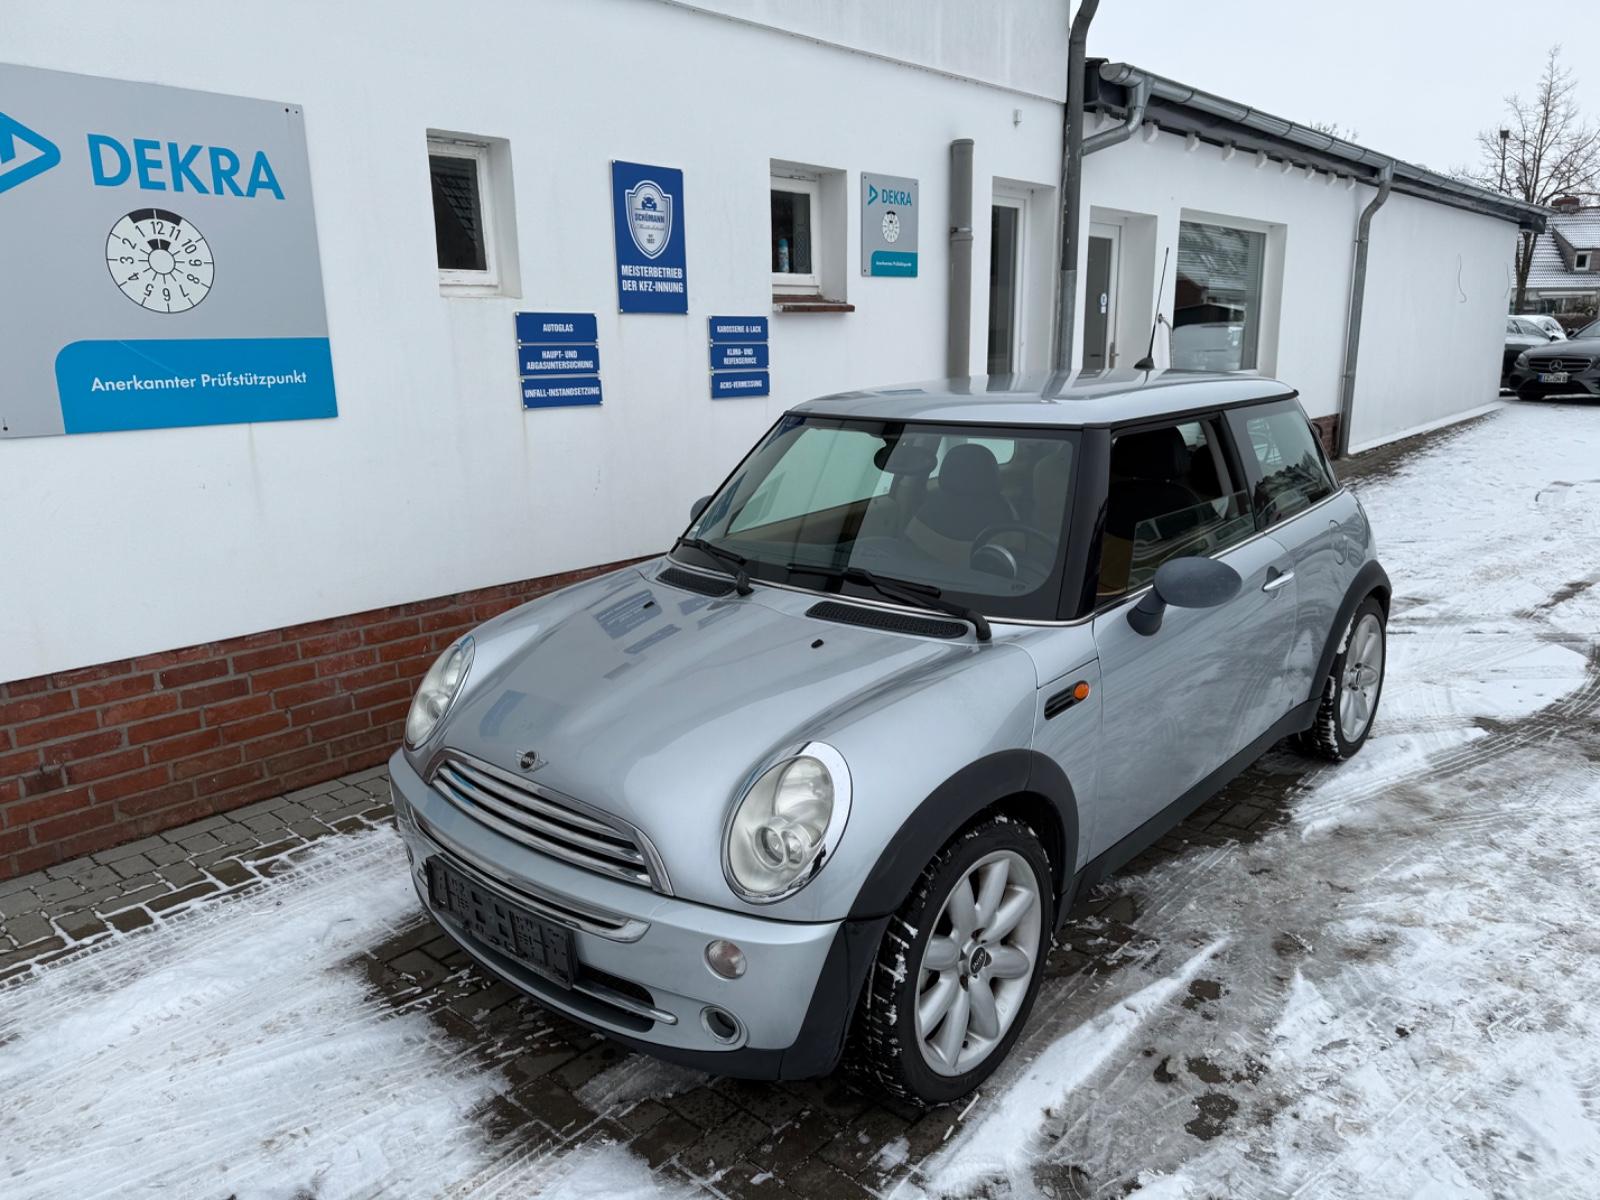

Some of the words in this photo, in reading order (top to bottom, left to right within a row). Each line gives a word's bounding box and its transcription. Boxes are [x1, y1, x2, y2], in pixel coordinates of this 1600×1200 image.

[87, 133, 286, 200] DEKRA
[881, 189, 912, 206] DEKRA
[135, 225, 145, 238] 1
[150, 221, 165, 235] 12
[169, 226, 181, 241] 11
[122, 237, 137, 250] 2
[181, 238, 197, 255] 10
[119, 256, 134, 265] 3
[128, 272, 139, 281] 4
[621, 265, 683, 279] MEISTERBETRIEB
[186, 273, 200, 285] 8
[143, 283, 154, 297] 5
[179, 284, 189, 298] 7
[622, 280, 637, 291] DER
[639, 281, 684, 293] KFZ-INNUNG
[542, 323, 574, 333] AUTOGLAS
[541, 350, 563, 359] HAUPT-
[564, 350, 578, 358] UND
[526, 360, 594, 370] ABGASUNTERSUCHUNG
[91, 375, 197, 393] Anerkannter
[201, 369, 307, 388] Prüfstützpunkt
[524, 387, 600, 398] UNFALL-INSTANDSETZUNG
